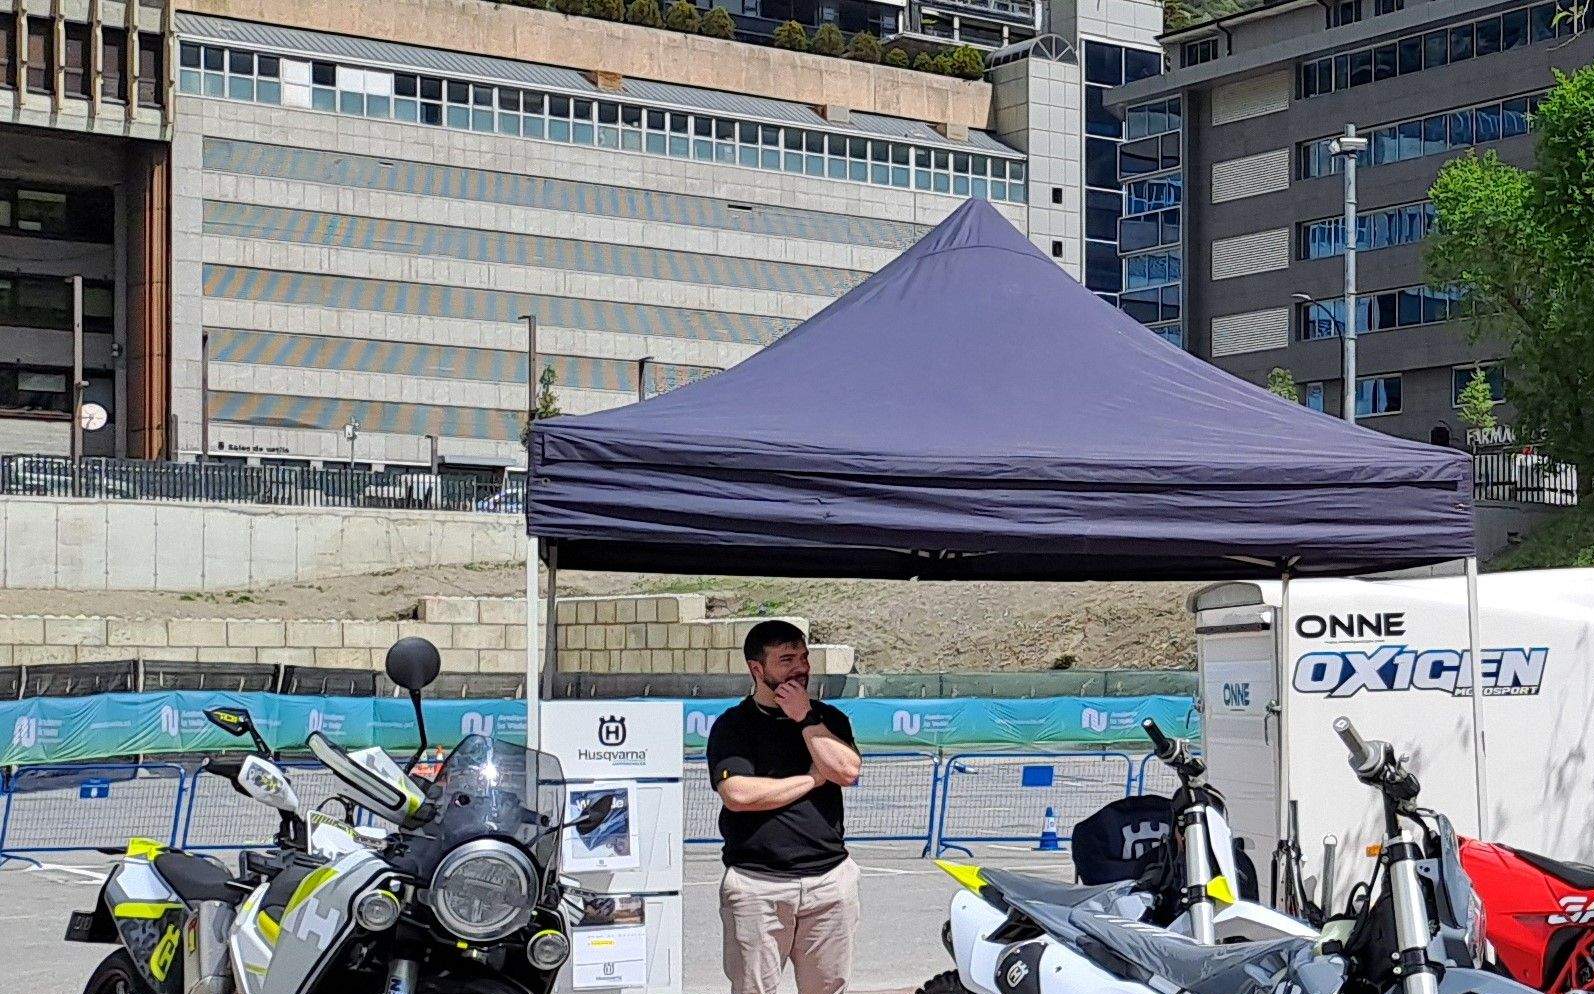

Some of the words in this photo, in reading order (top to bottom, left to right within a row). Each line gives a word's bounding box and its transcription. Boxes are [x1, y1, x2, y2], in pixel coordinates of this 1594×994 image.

[1295, 612, 1406, 639] ONNE
[1454, 686, 1541, 698] MOOSPORT
[578, 749, 648, 761] Husqvarna
